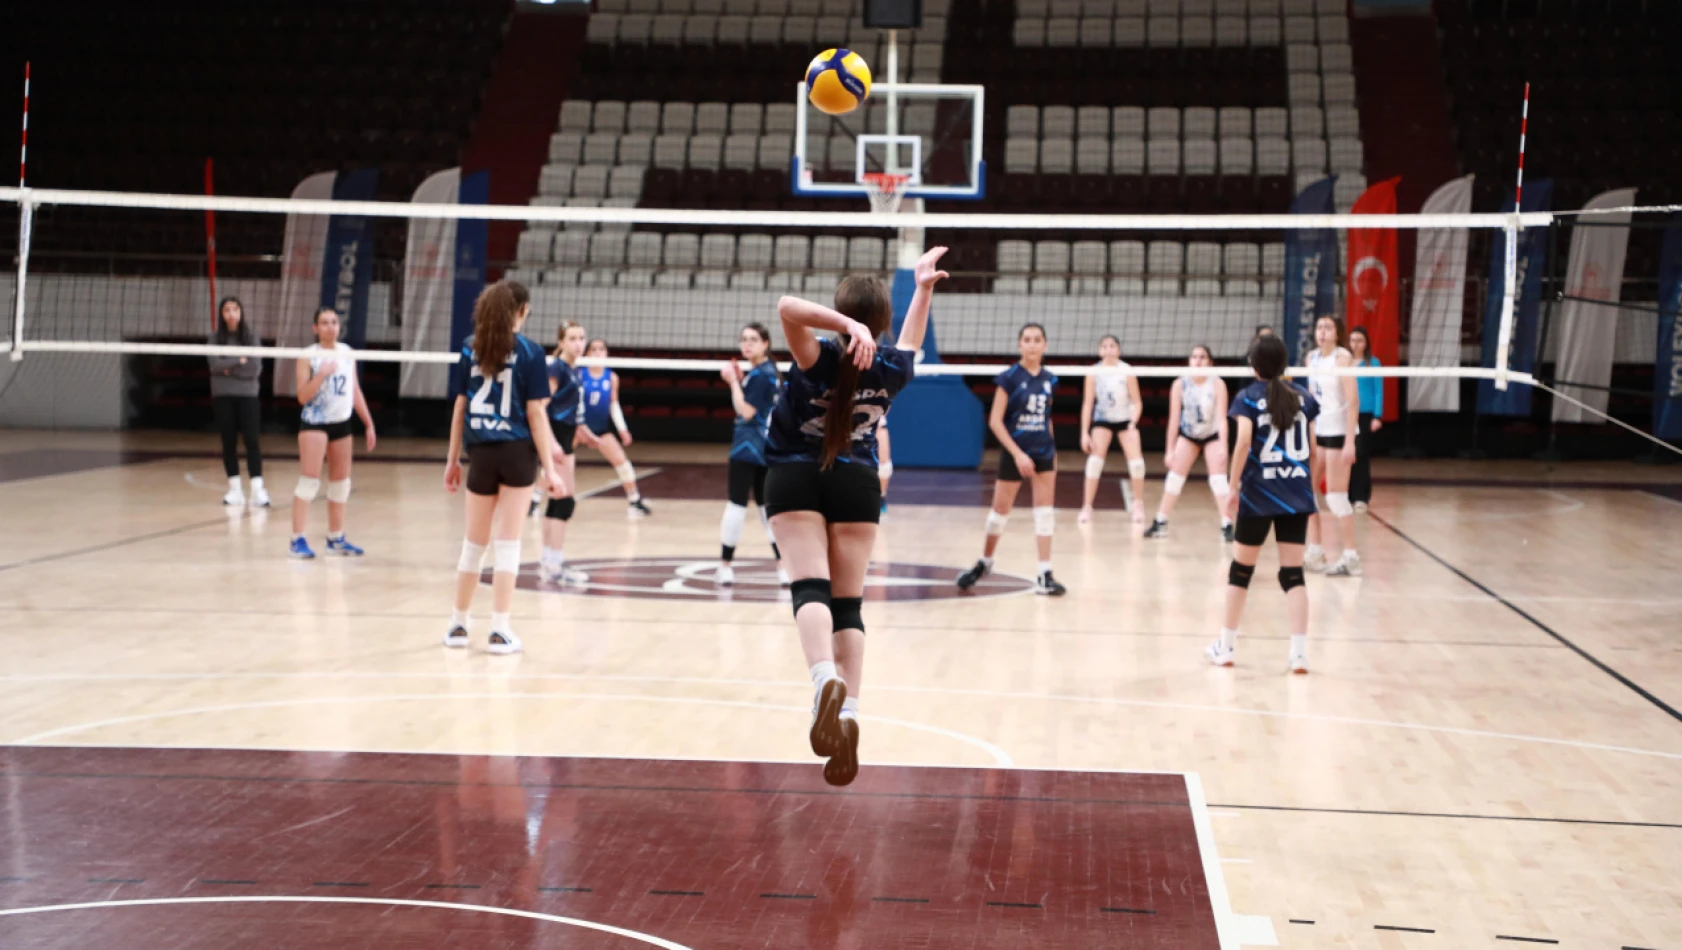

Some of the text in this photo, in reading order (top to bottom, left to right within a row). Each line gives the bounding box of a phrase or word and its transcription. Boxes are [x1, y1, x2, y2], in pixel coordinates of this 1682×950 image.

[332, 375, 347, 396] 12
[470, 364, 513, 417] 21
[470, 417, 512, 431] EVA
[1257, 410, 1310, 463] 20
[1263, 465, 1307, 479] EVA
